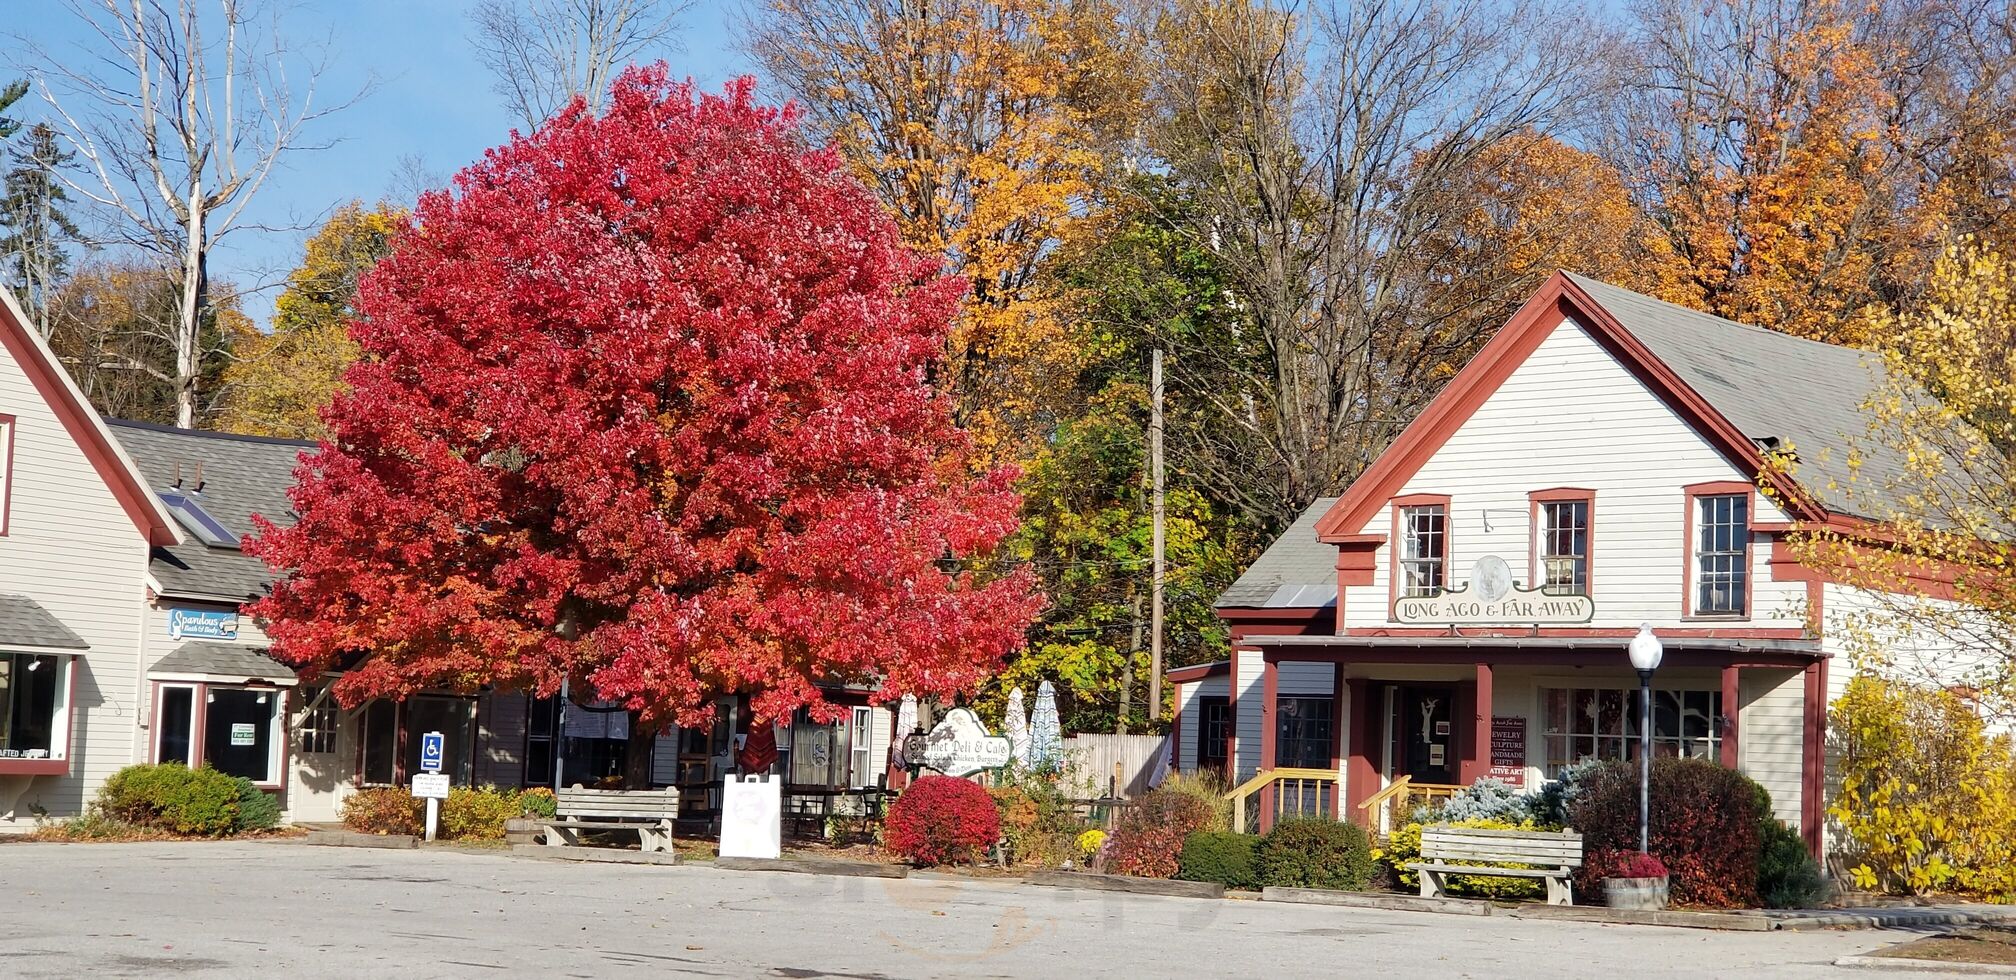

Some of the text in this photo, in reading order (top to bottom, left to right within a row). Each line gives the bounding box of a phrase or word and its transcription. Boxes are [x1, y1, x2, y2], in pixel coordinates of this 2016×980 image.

[1403, 599, 1584, 619] LONG AGO & FAR AWAY
[204, 626, 218, 636] Body
[909, 740, 948, 752] Gourmet
[952, 740, 971, 753] Deli
[974, 741, 983, 753] &
[1491, 741, 1524, 749] CULPTURE
[1491, 751, 1524, 759] ANDMADE
[1490, 767, 1509, 775] ATIVE
